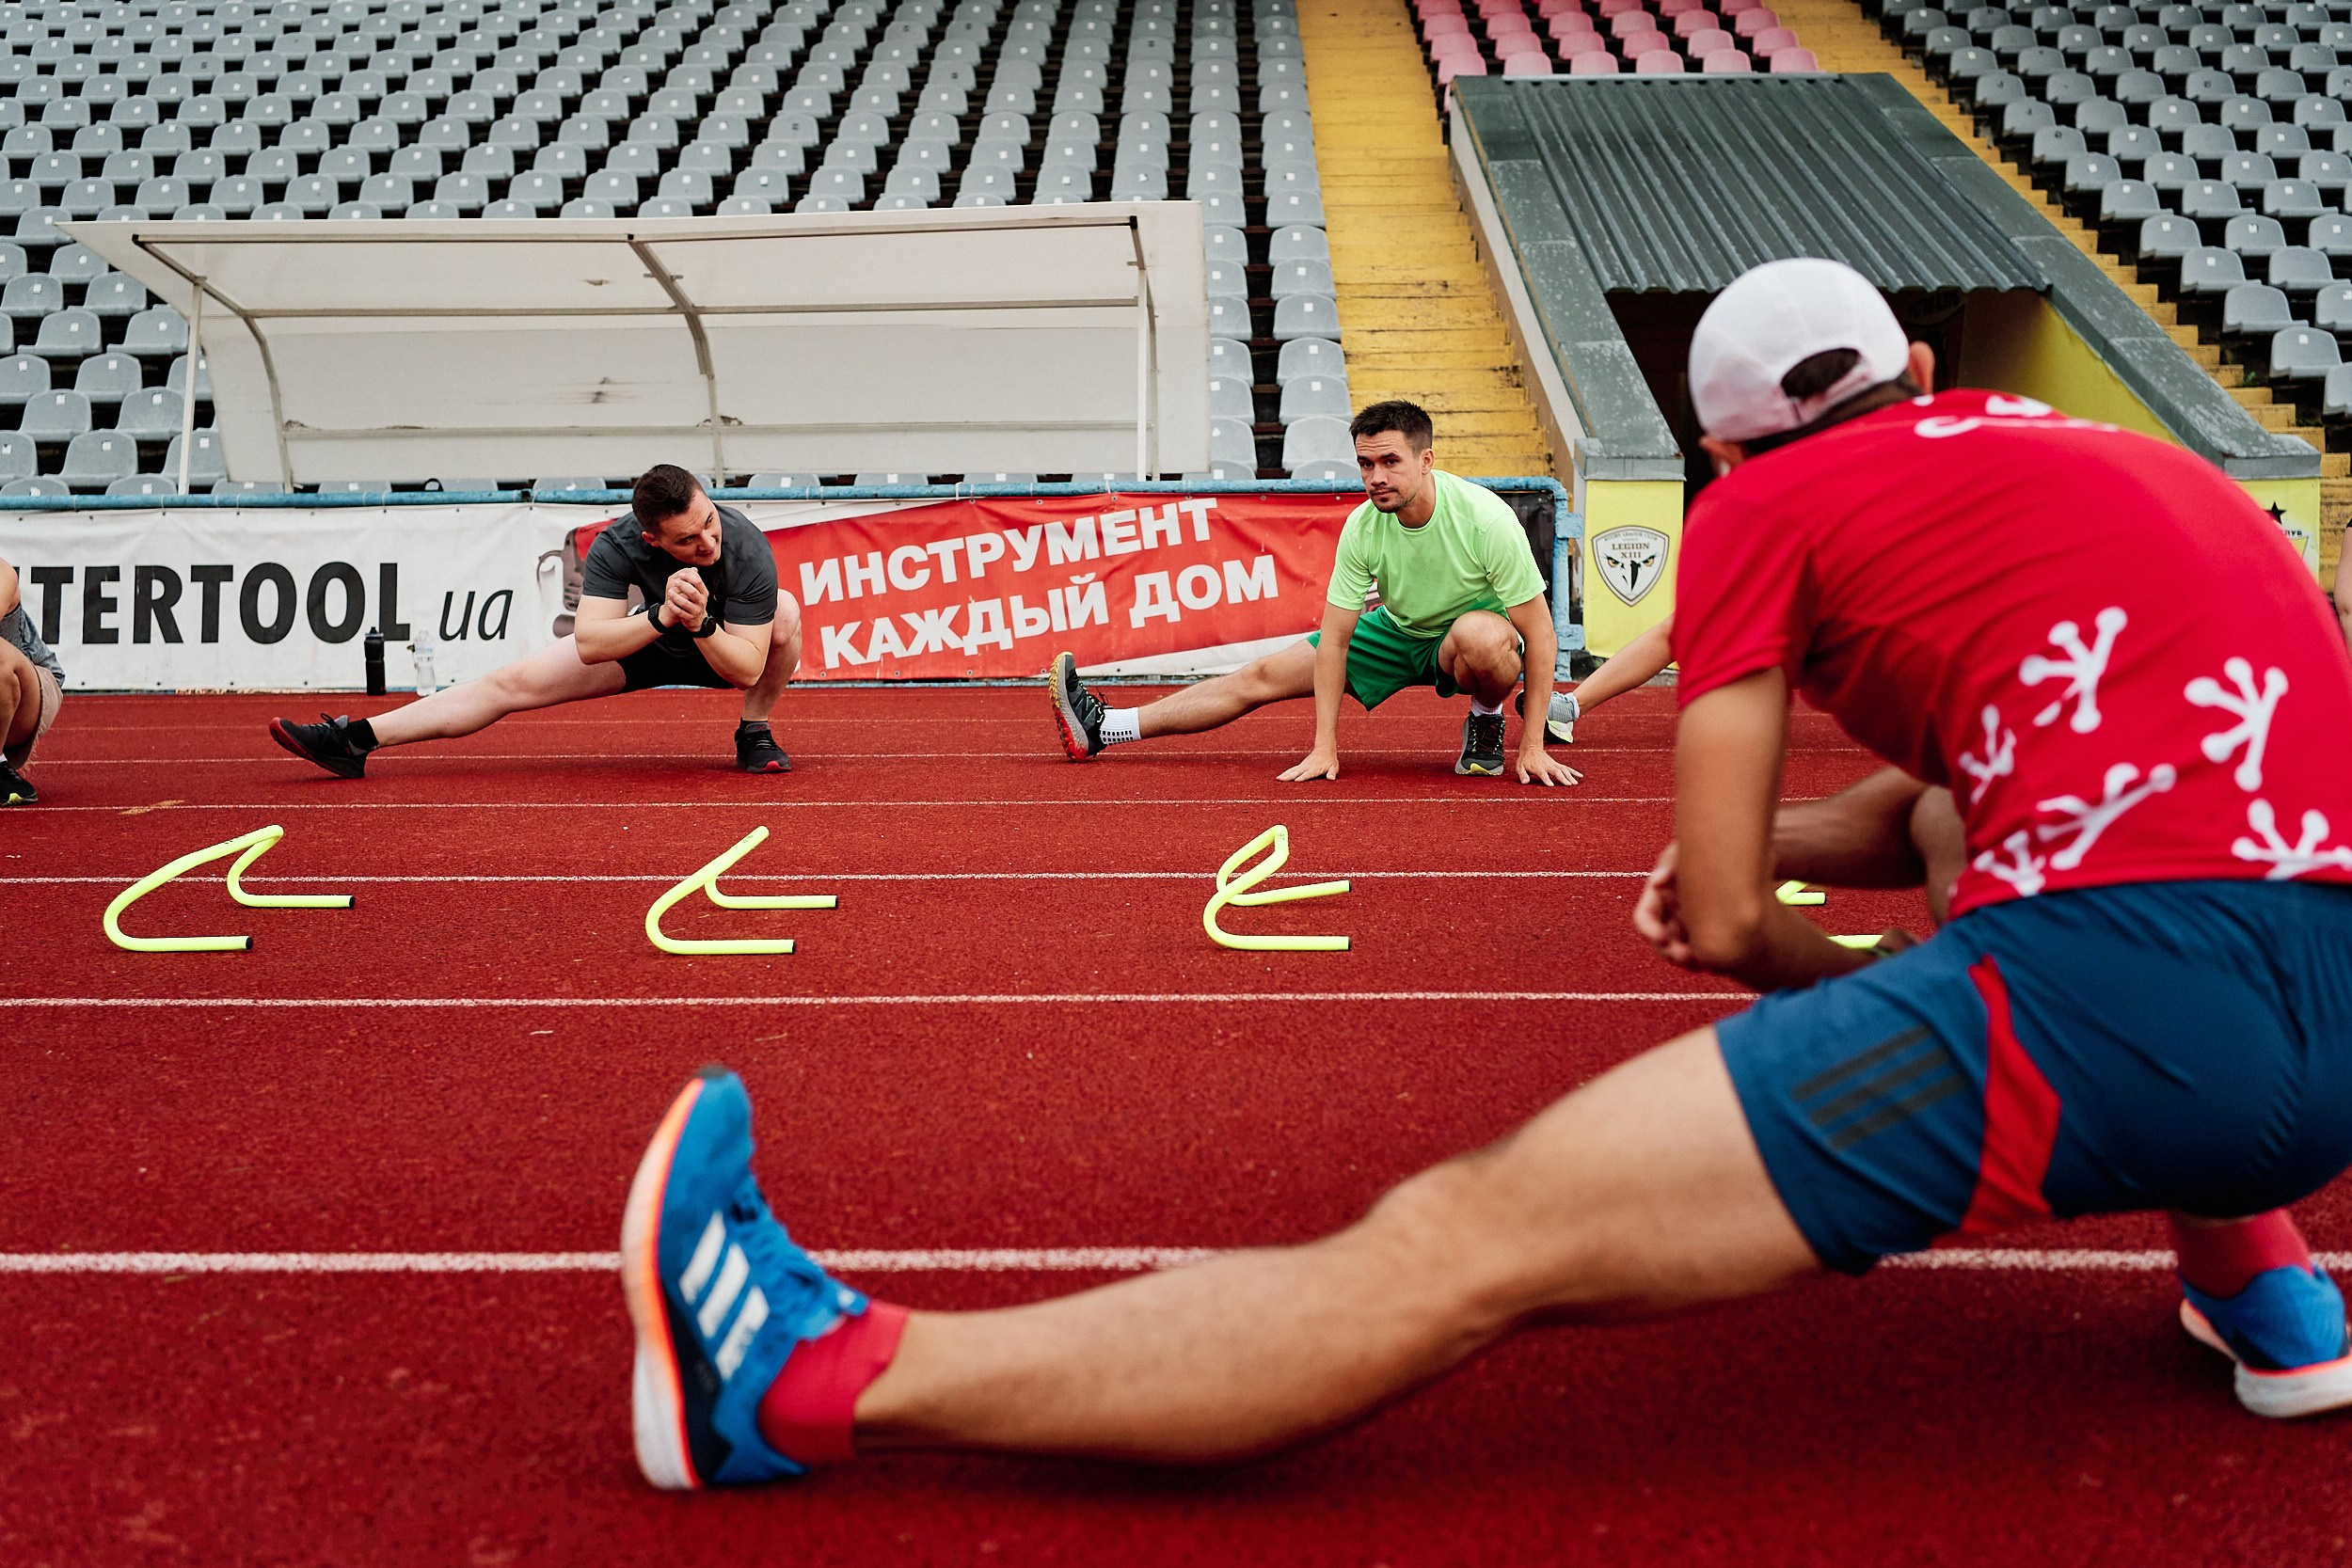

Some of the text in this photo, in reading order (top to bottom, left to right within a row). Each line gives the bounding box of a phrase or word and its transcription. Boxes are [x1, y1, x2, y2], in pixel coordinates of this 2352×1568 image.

[798, 497, 1218, 607] ИНСТРУМЕНТ
[1612, 542, 1650, 550] LEGION
[12, 561, 514, 644] TERTOOL ua
[819, 554, 1279, 670] КАЖДЫЙ ДОМ
